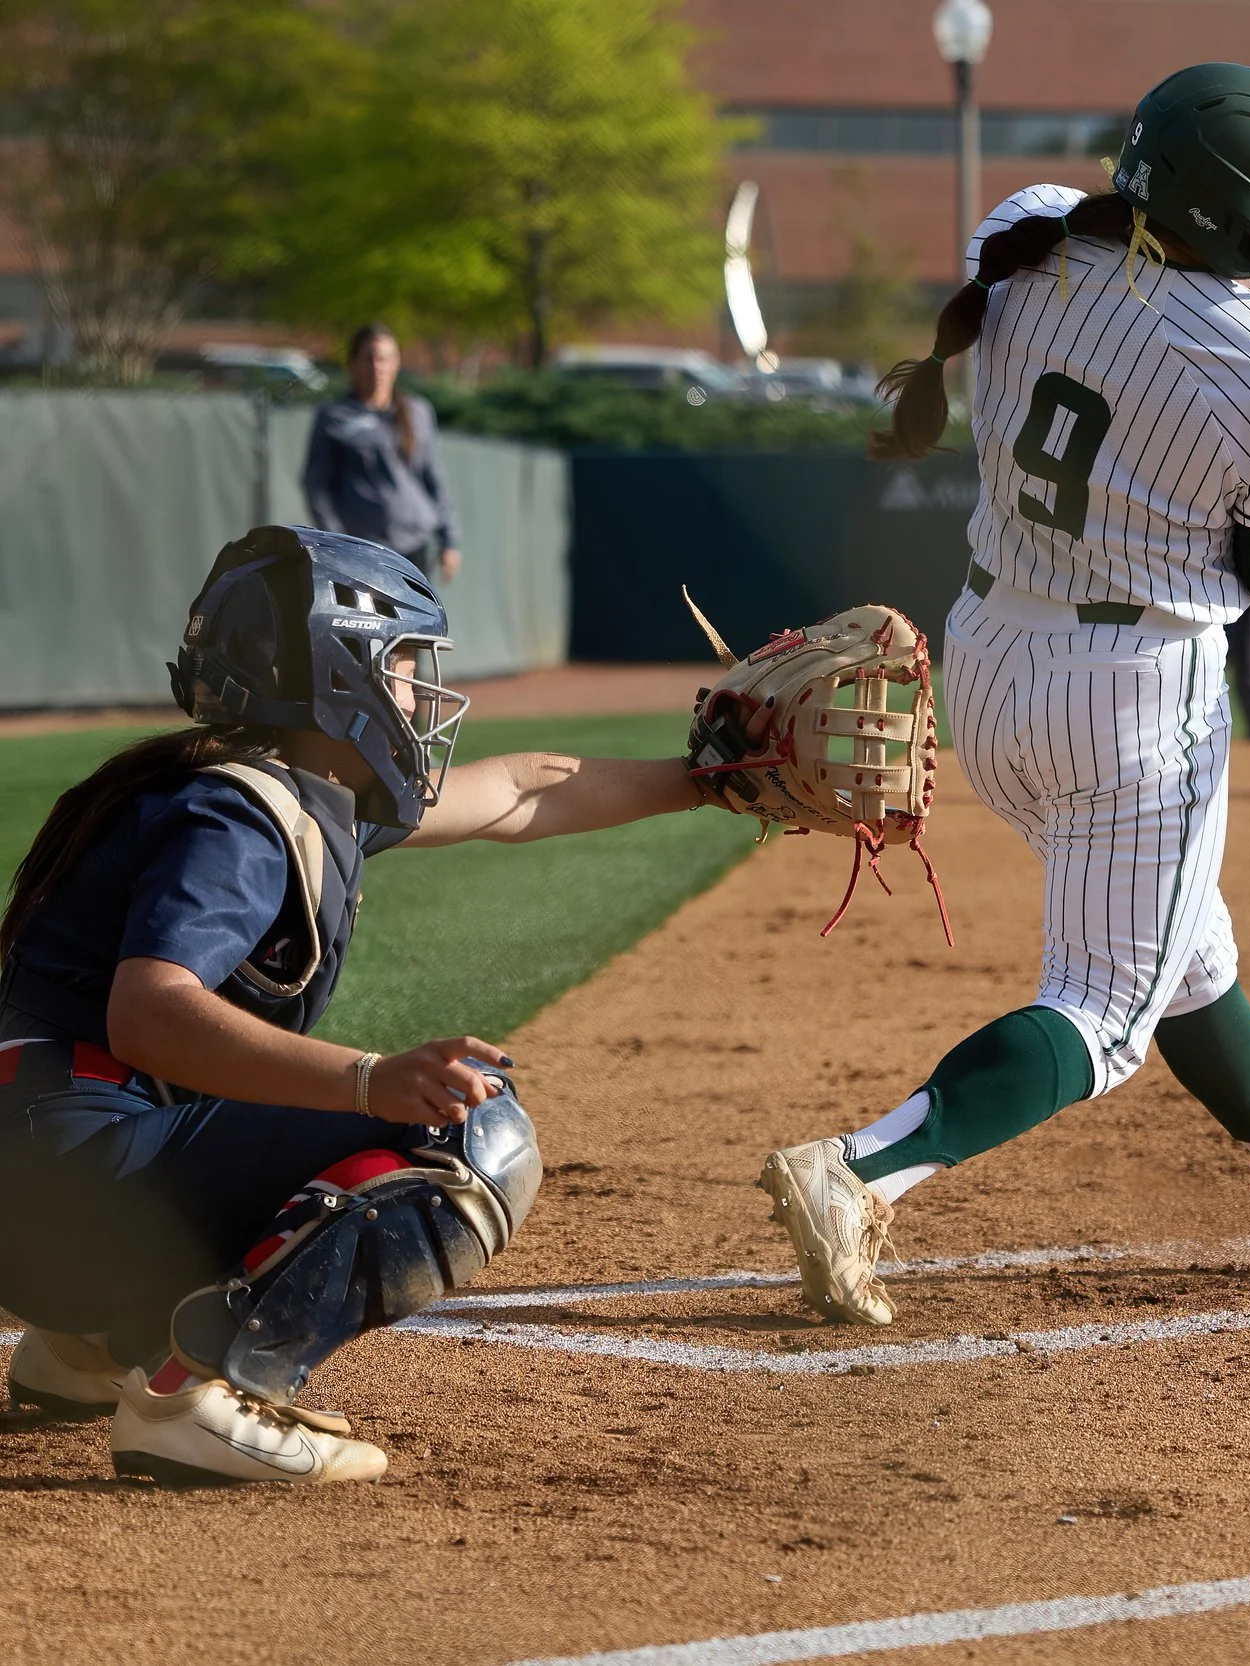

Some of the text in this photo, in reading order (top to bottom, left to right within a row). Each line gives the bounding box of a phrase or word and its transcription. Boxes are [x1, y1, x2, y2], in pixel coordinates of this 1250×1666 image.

[1131, 122, 1143, 146] 9
[1188, 207, 1218, 231] Rawlings
[1012, 371, 1112, 543] 9
[331, 618, 381, 630] EASTON
